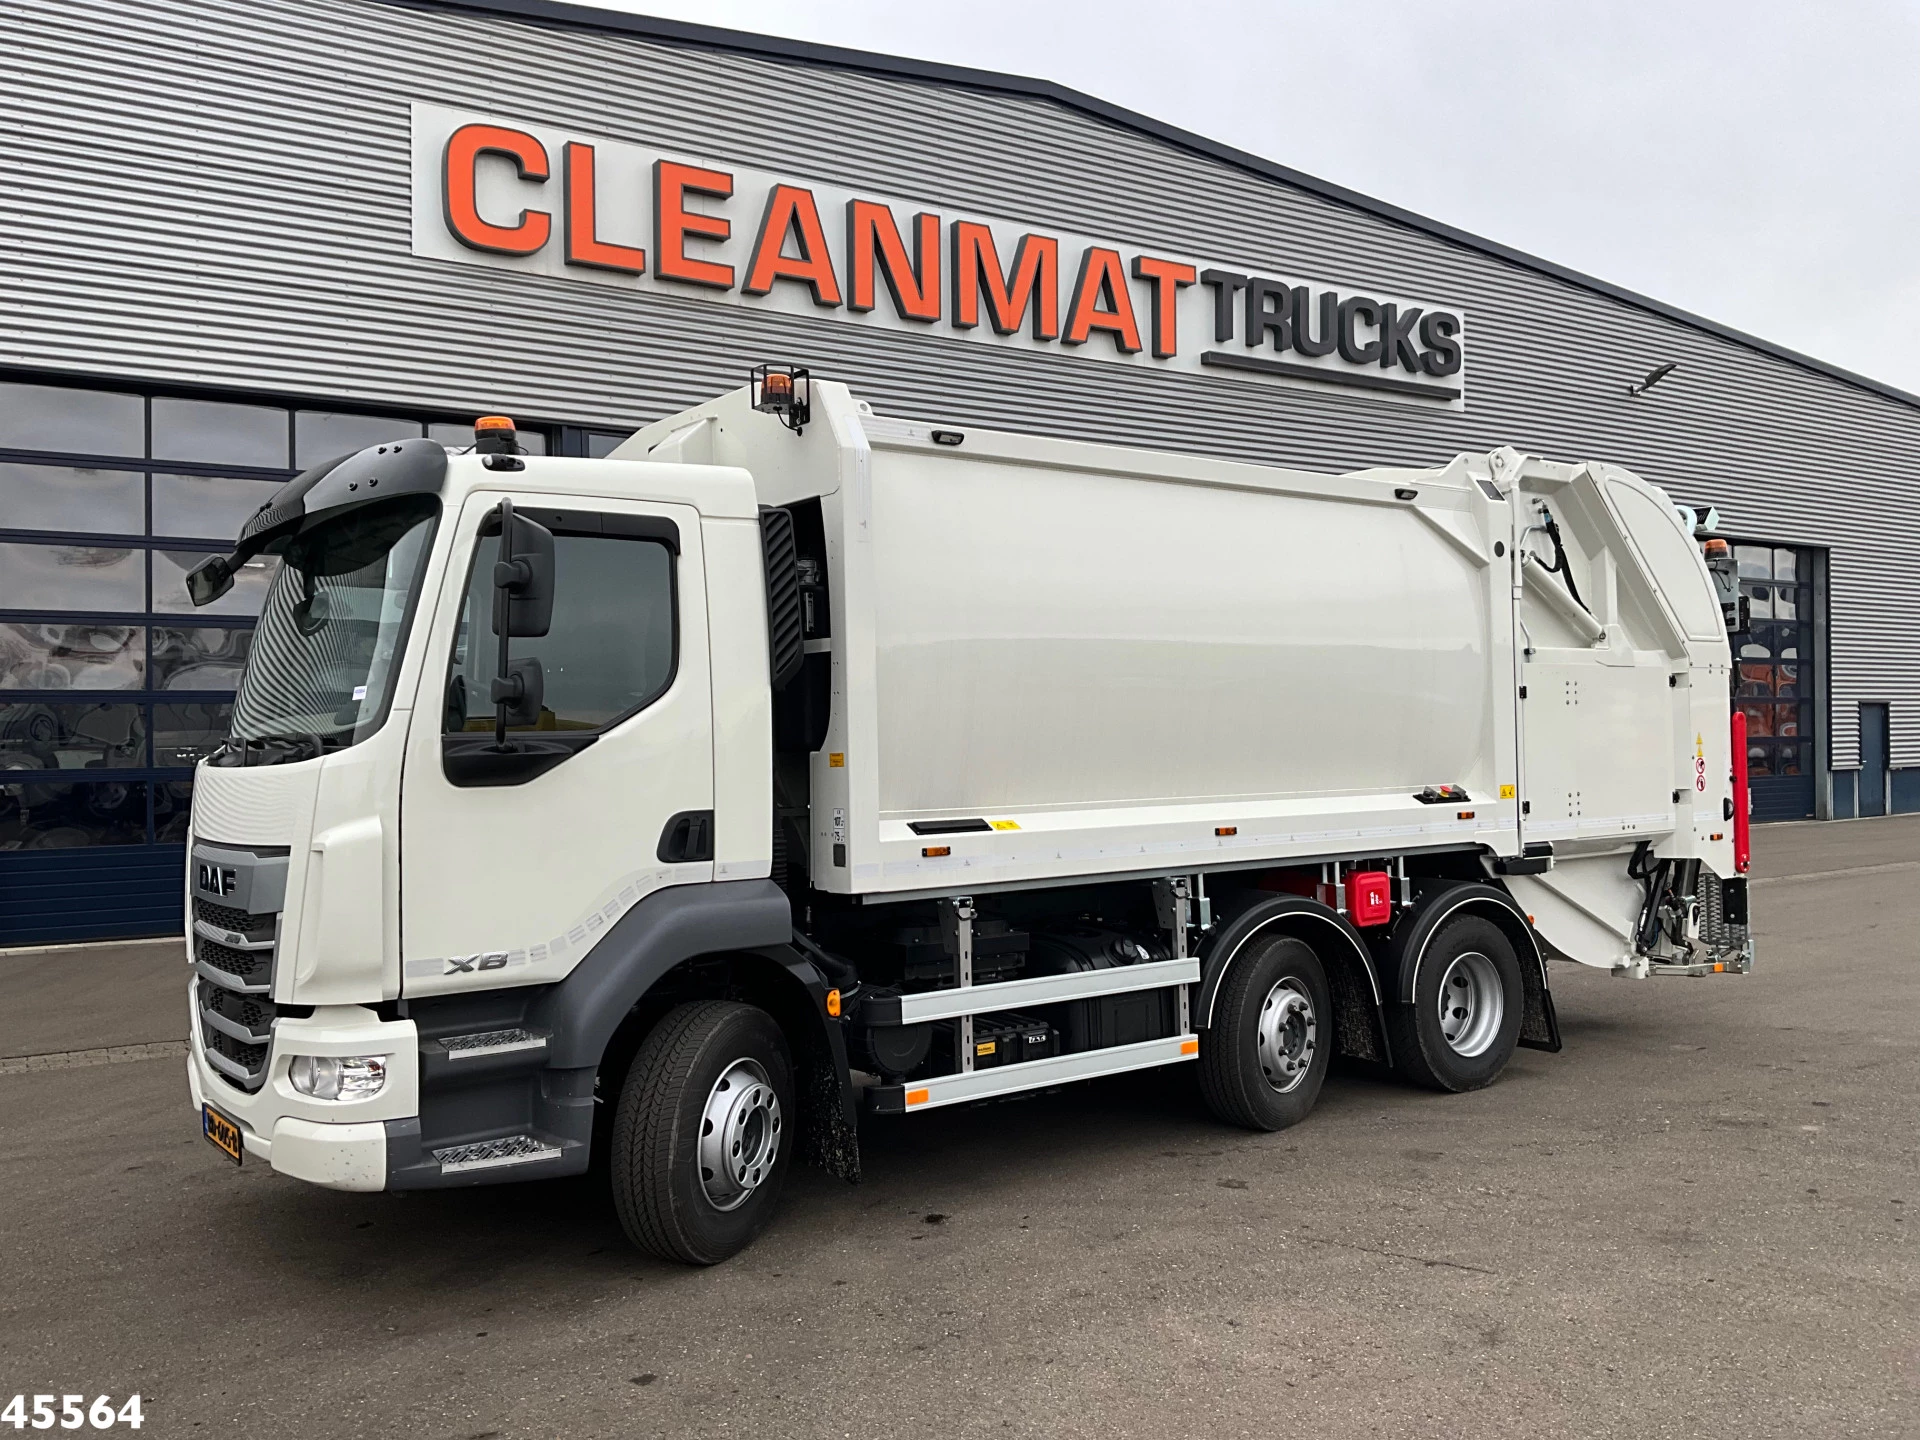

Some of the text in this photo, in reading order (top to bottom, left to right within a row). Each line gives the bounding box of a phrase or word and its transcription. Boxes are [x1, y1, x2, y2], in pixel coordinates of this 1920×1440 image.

[443, 122, 1462, 378] CLEANMAT TRUCKS
[199, 864, 237, 898] DAF
[443, 950, 509, 975] XB
